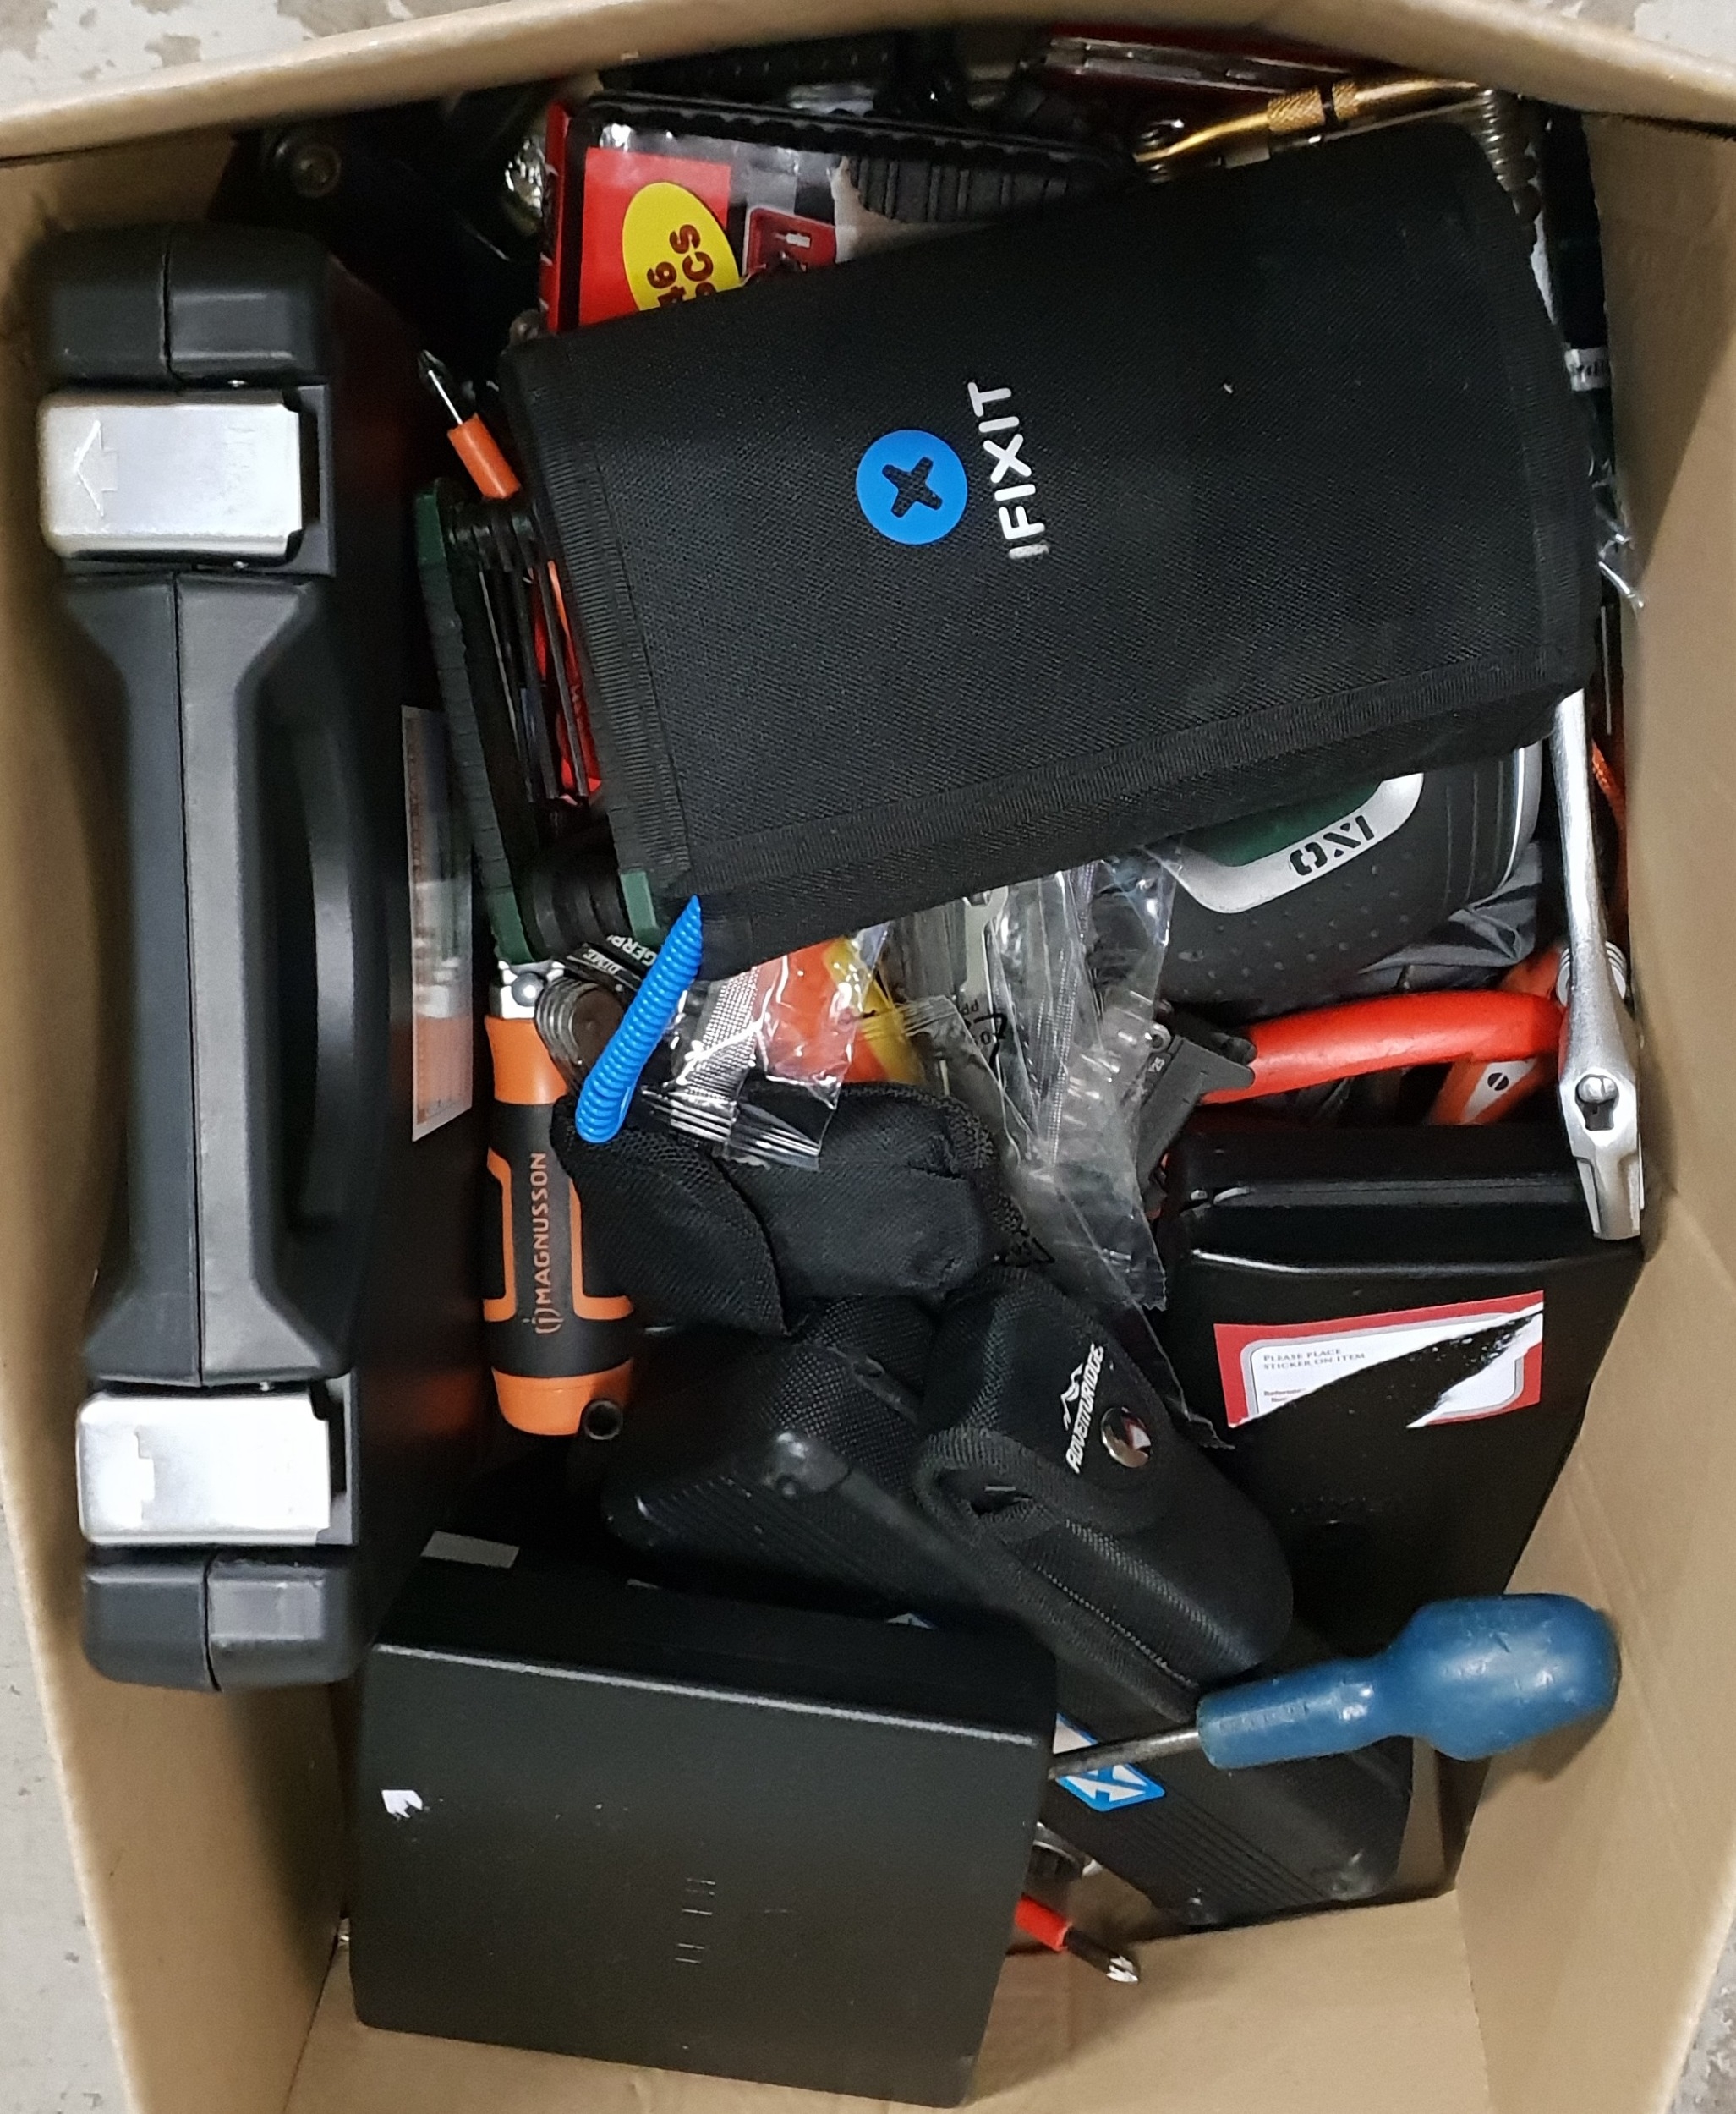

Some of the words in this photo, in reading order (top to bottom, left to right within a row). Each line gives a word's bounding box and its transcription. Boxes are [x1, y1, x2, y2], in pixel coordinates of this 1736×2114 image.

[967, 381, 1049, 559] IFIXIT
[530, 1153, 551, 1304] MAGNUSSON
[1263, 1360, 1311, 1369] STICKER
[1314, 1356, 1333, 1365] ON
[1337, 1354, 1366, 1362] ITEM
[1306, 1349, 1341, 1359] PLACE
